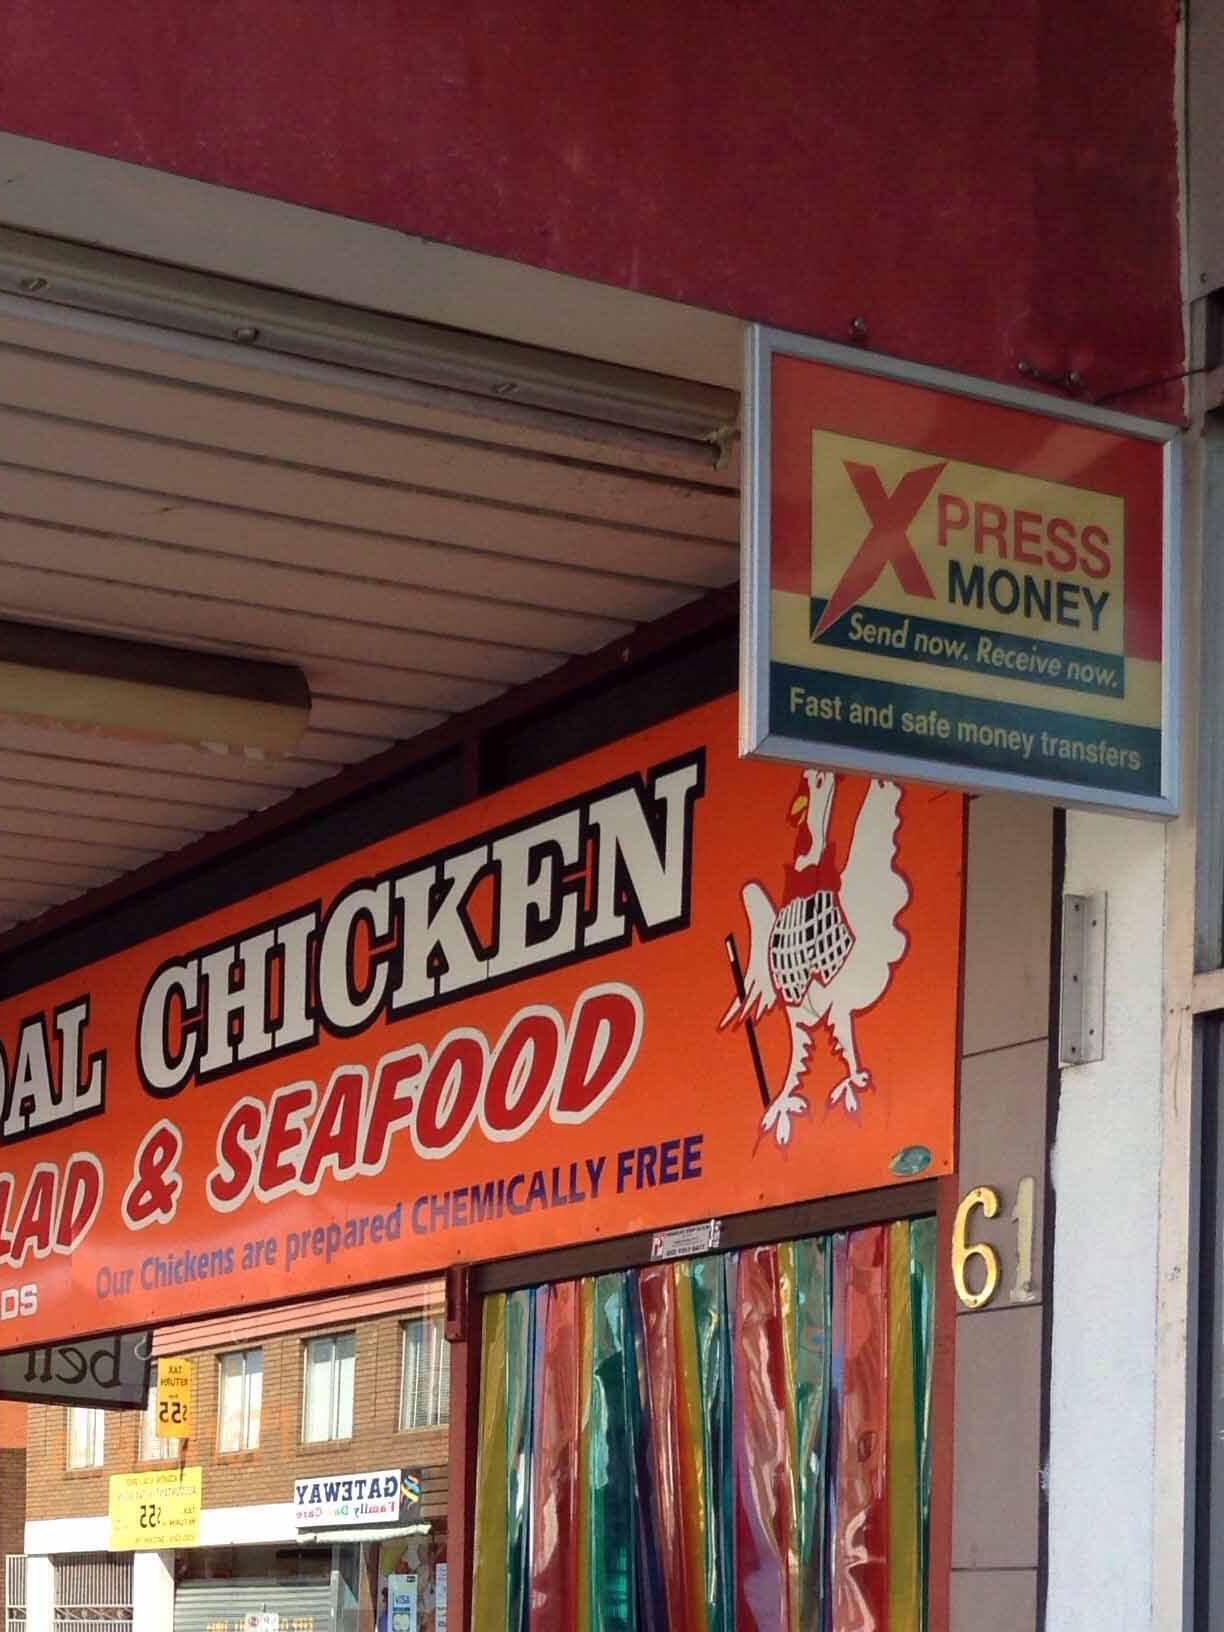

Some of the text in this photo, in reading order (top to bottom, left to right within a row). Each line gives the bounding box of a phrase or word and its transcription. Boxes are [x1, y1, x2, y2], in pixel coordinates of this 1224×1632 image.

[849, 612, 1119, 688] Send now. Receive now.
[947, 559, 1111, 632] MONEY
[790, 687, 1142, 771] Fast and safe money transfers
[138, 752, 702, 1092] CHICKEN
[122, 1119, 183, 1231] &
[207, 982, 645, 1213] SEAFOOD
[96, 1134, 704, 1298] Our Chickens are prepared CHEMICALLY FREE
[951, 1176, 1037, 1308] 61
